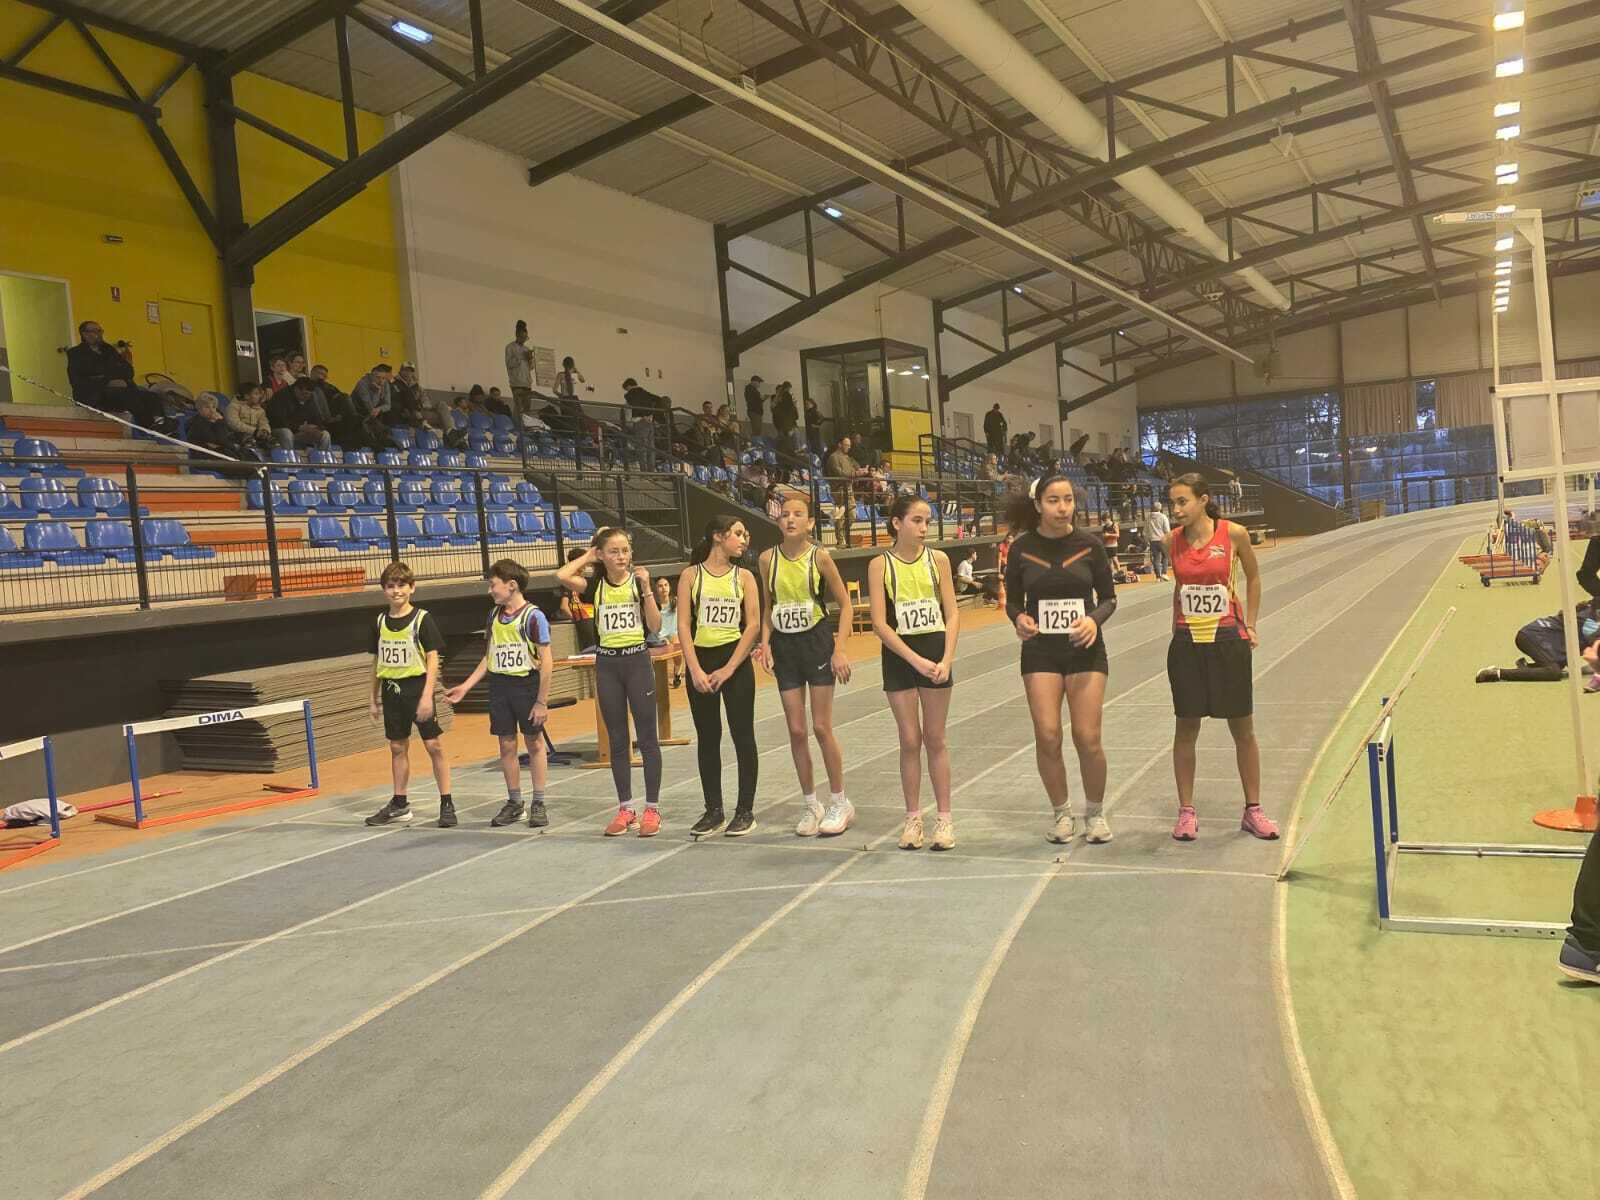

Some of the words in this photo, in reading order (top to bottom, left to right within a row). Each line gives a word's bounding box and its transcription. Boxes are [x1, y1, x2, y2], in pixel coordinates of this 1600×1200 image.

[1185, 594, 1222, 613] 1252
[603, 611, 636, 630] 1253
[705, 605, 736, 624] 1257
[776, 610, 809, 630] 1255
[902, 607, 936, 630] 1254
[381, 646, 408, 664] 1251
[495, 651, 523, 668] 1256
[198, 710, 244, 725] DIMA
